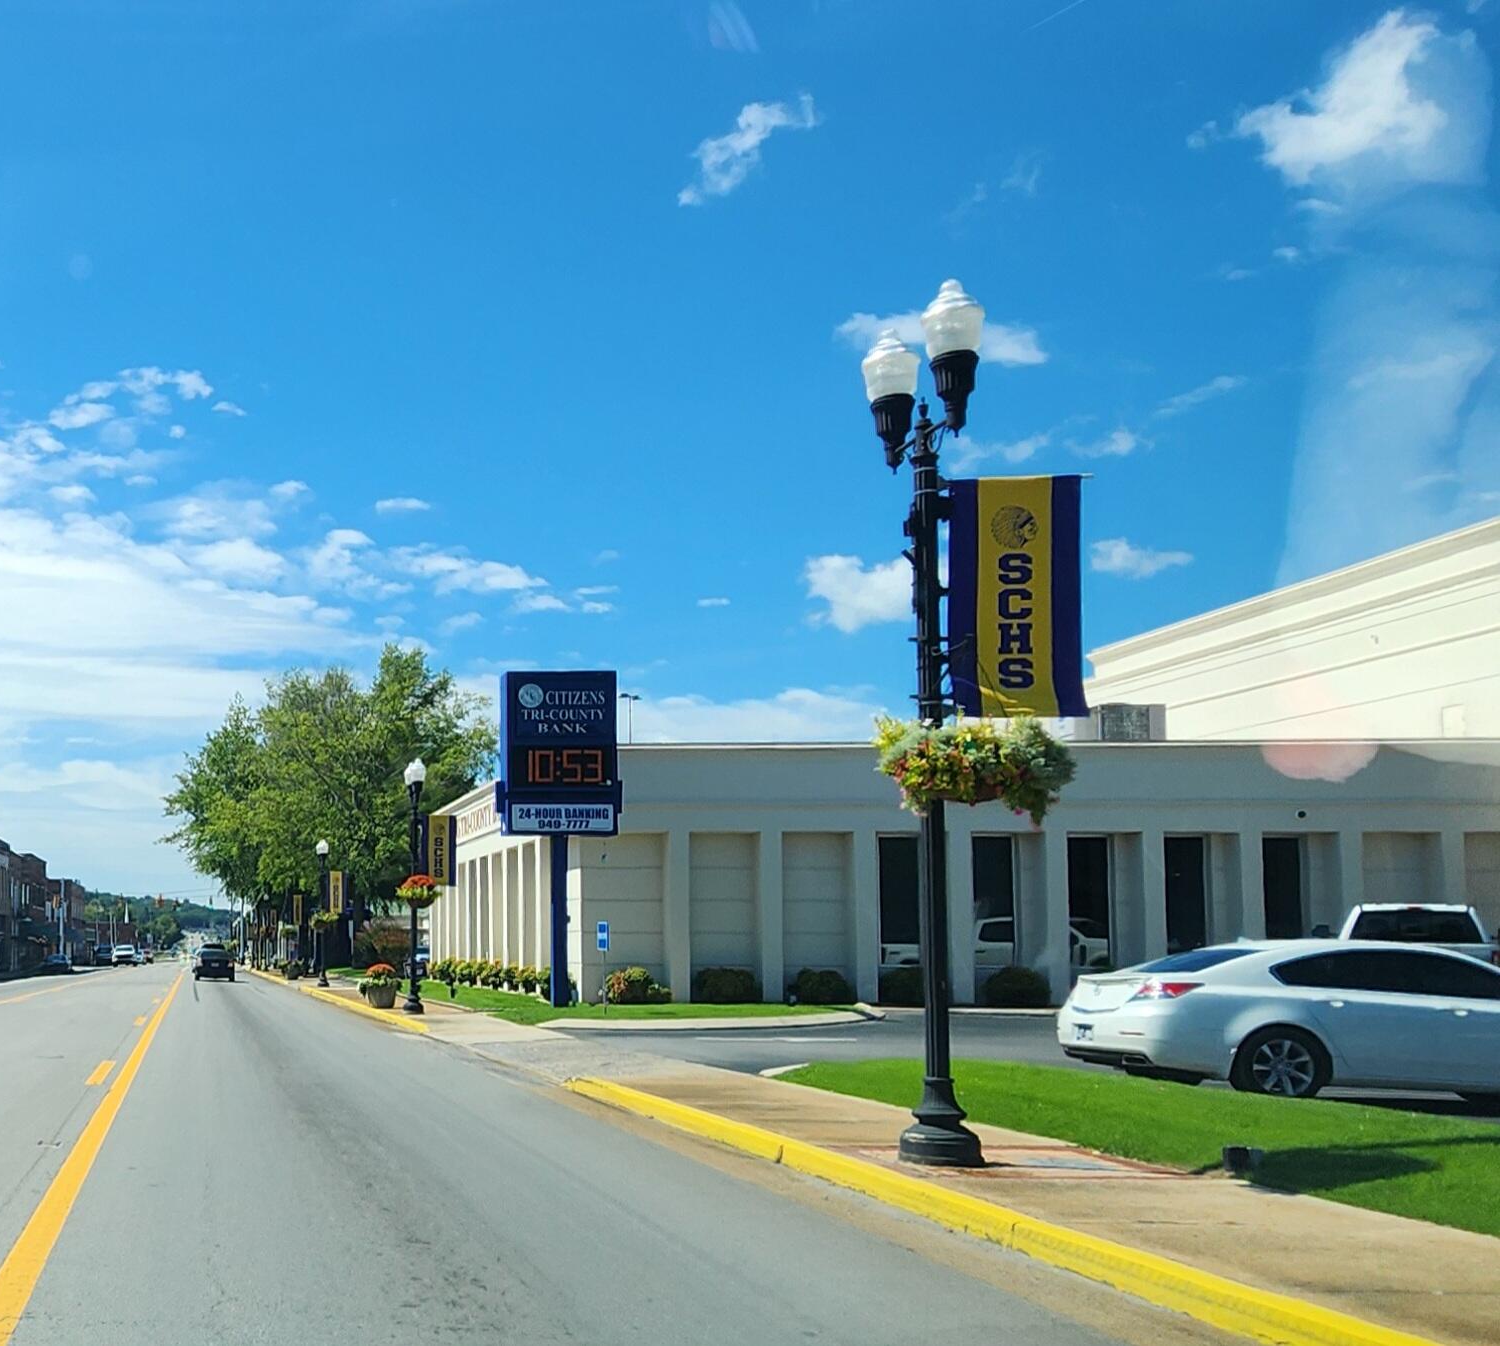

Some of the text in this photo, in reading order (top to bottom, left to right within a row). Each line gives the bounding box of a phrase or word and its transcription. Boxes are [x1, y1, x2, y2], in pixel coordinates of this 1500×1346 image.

[998, 552, 1035, 689] SCHS
[545, 690, 606, 706] CITIZENS
[520, 708, 606, 721] TRI-COUNTY
[538, 722, 588, 734] BANK
[527, 749, 603, 783] 10:53
[518, 807, 610, 820] 24-HOUR BANKING
[537, 820, 591, 829] 949-7777
[434, 837, 443, 877] SCHS
